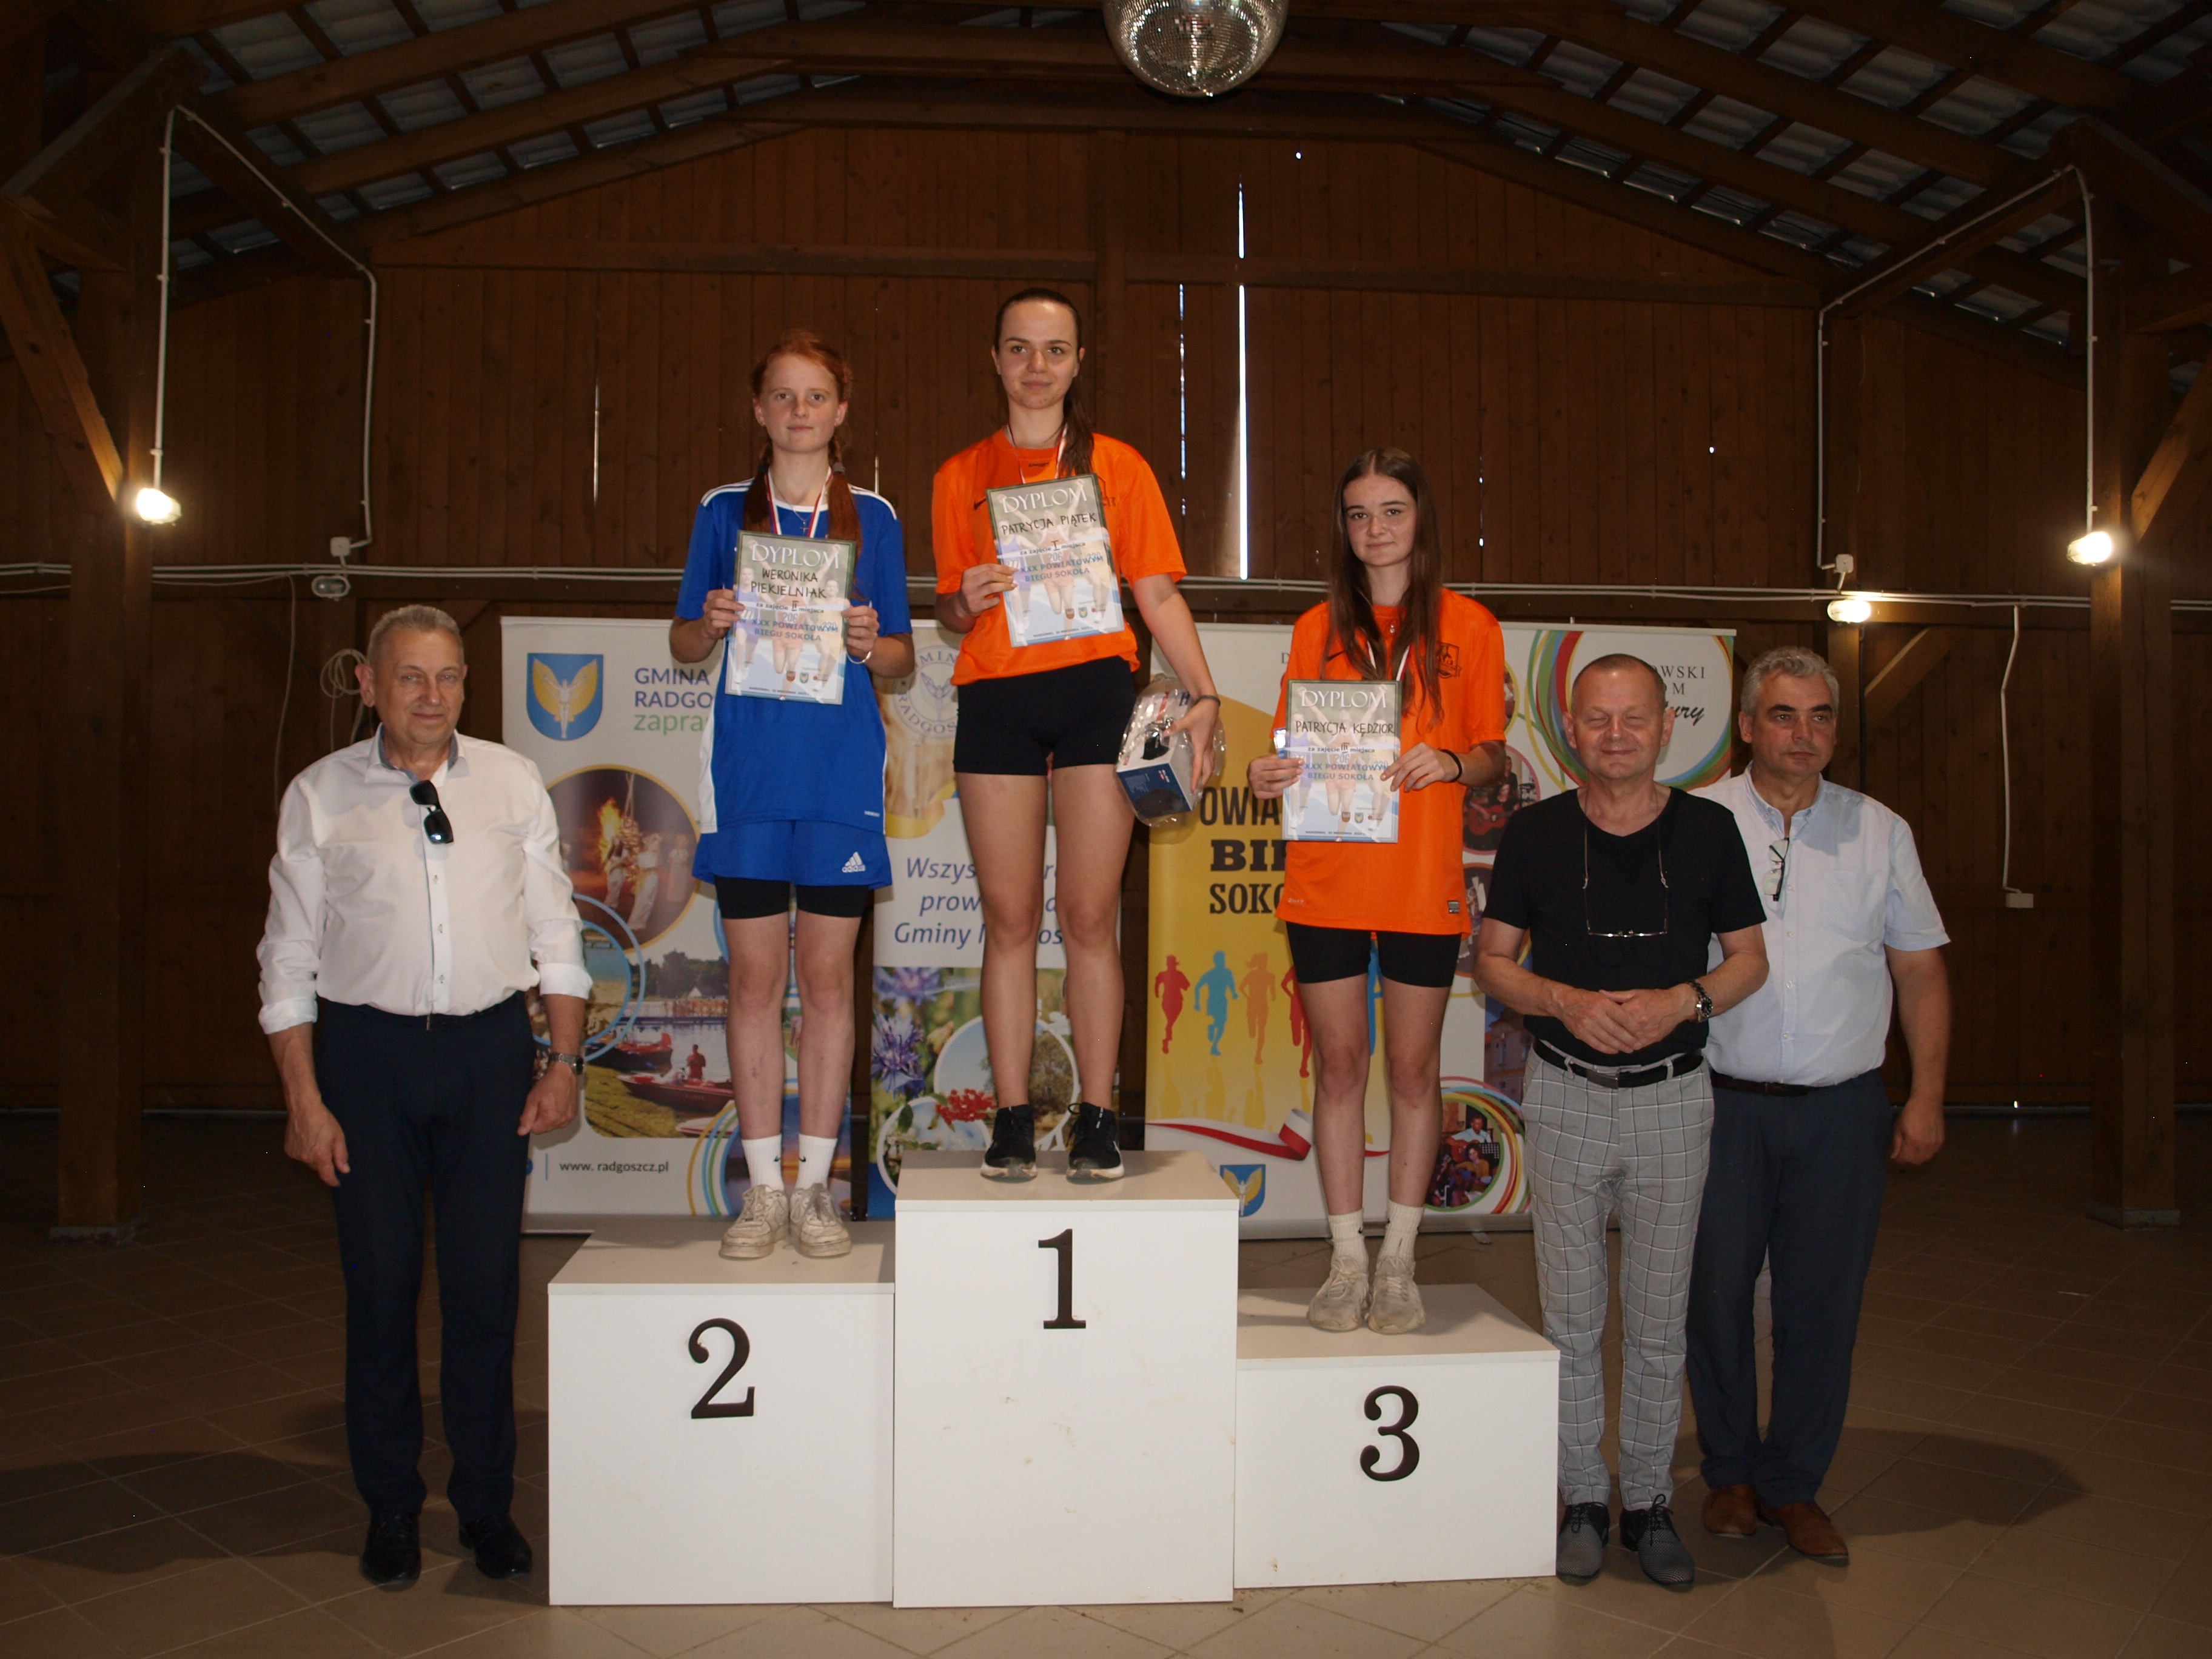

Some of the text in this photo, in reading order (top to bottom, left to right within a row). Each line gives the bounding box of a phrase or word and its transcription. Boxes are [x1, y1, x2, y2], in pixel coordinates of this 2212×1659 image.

[1003, 488, 1087, 513] DYPLOM
[1002, 512, 1096, 535] PATRYCJA PIĄTEK
[751, 544, 839, 568] DYPLOM
[1041, 555, 1103, 572] POWIATOWYM
[762, 568, 818, 582] WERONIKA
[1025, 568, 1090, 581] BIEGU SOKOŁA
[751, 581, 826, 598] PIEKIELNIAK
[754, 628, 821, 641] BIEGU SOKOŁA
[773, 620, 838, 632] POWIATOWYM
[634, 667, 709, 685] GMINA
[1651, 665, 1704, 679] WSKI
[1301, 690, 1386, 708] DYPLOM
[634, 714, 708, 736] zapra
[1296, 721, 1395, 737] PATRYCJA KĘDZIOR
[1338, 773, 1373, 781] SOKOŁA
[894, 922, 971, 950] Gminy
[1038, 1228, 1086, 1329] 1
[688, 1318, 755, 1419] 2
[1359, 1385, 1419, 1481] 3
